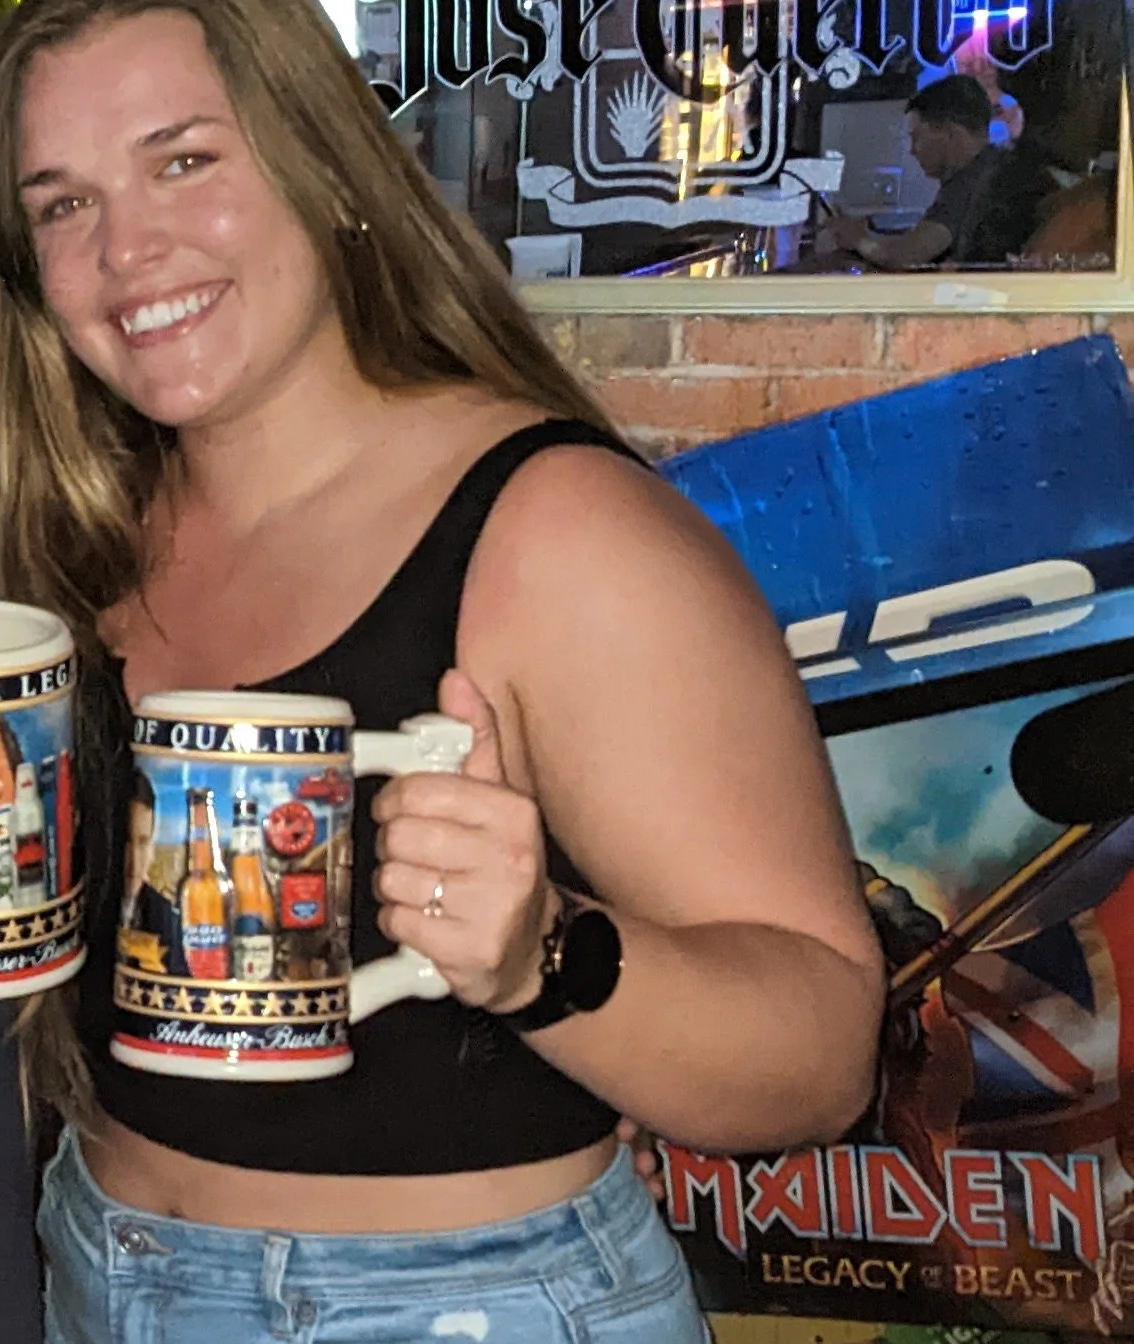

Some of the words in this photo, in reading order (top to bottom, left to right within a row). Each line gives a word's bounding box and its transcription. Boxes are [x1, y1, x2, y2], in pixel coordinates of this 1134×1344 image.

[133, 718, 158, 744] OF
[170, 726, 332, 753] QUALITY
[658, 1141, 1107, 1265] MAIDEN
[762, 1254, 911, 1292] LEGACY
[954, 1264, 1083, 1300] BEAST
